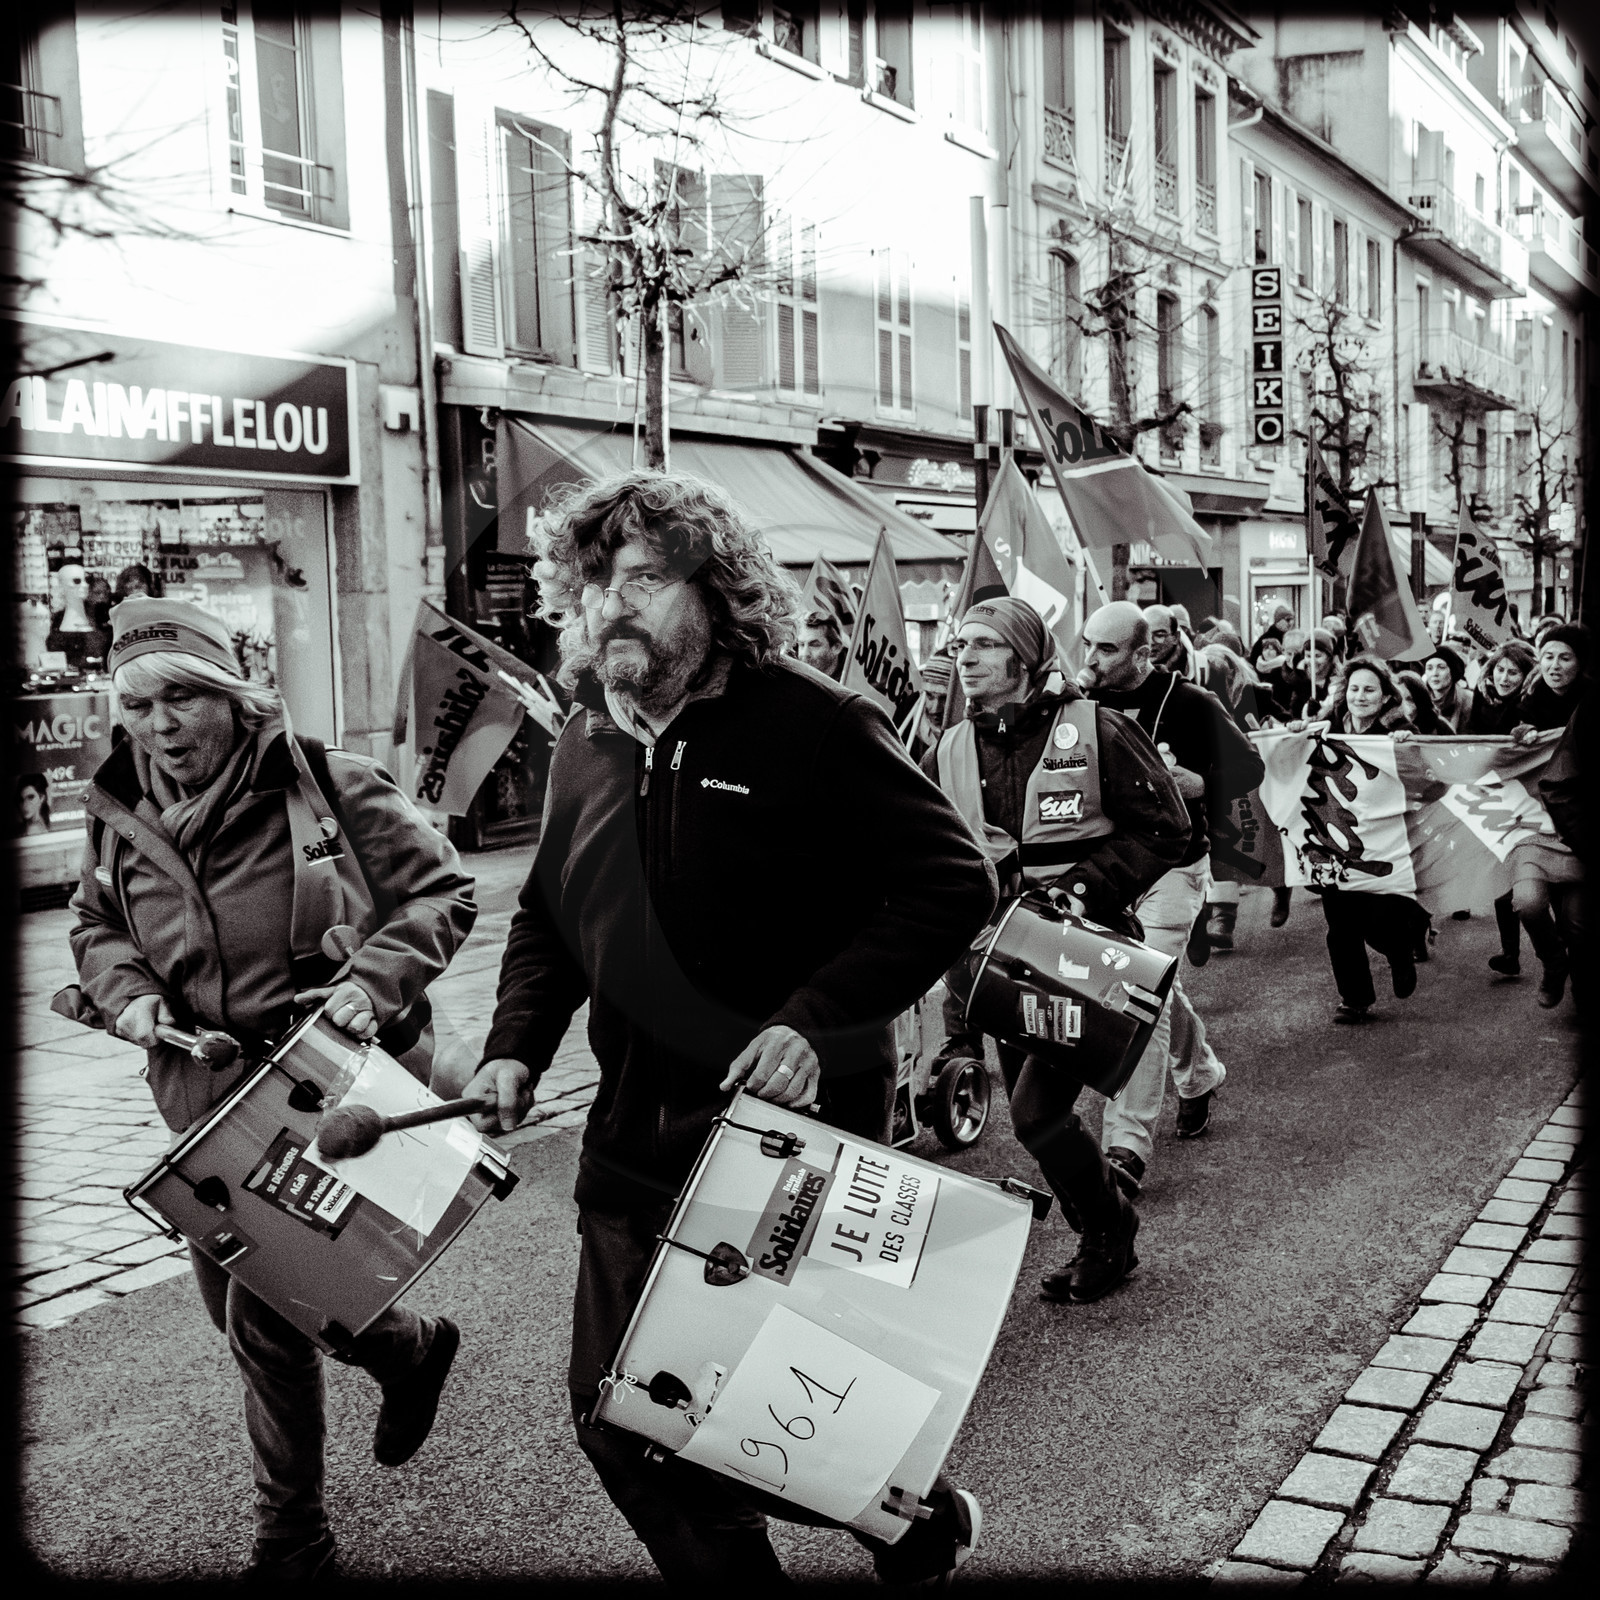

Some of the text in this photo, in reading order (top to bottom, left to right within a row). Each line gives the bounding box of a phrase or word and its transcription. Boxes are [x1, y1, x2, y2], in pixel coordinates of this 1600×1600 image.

[1254, 271, 1282, 441] SEIKO
[15, 713, 101, 743] MAGIC
[709, 779, 750, 795] Columbia
[1040, 793, 1081, 816] Sud
[759, 1172, 826, 1276] Solidaires
[830, 1155, 890, 1263] JE LUTTE
[878, 1174, 921, 1263] DES CLASSES
[724, 1366, 857, 1492] 1961
